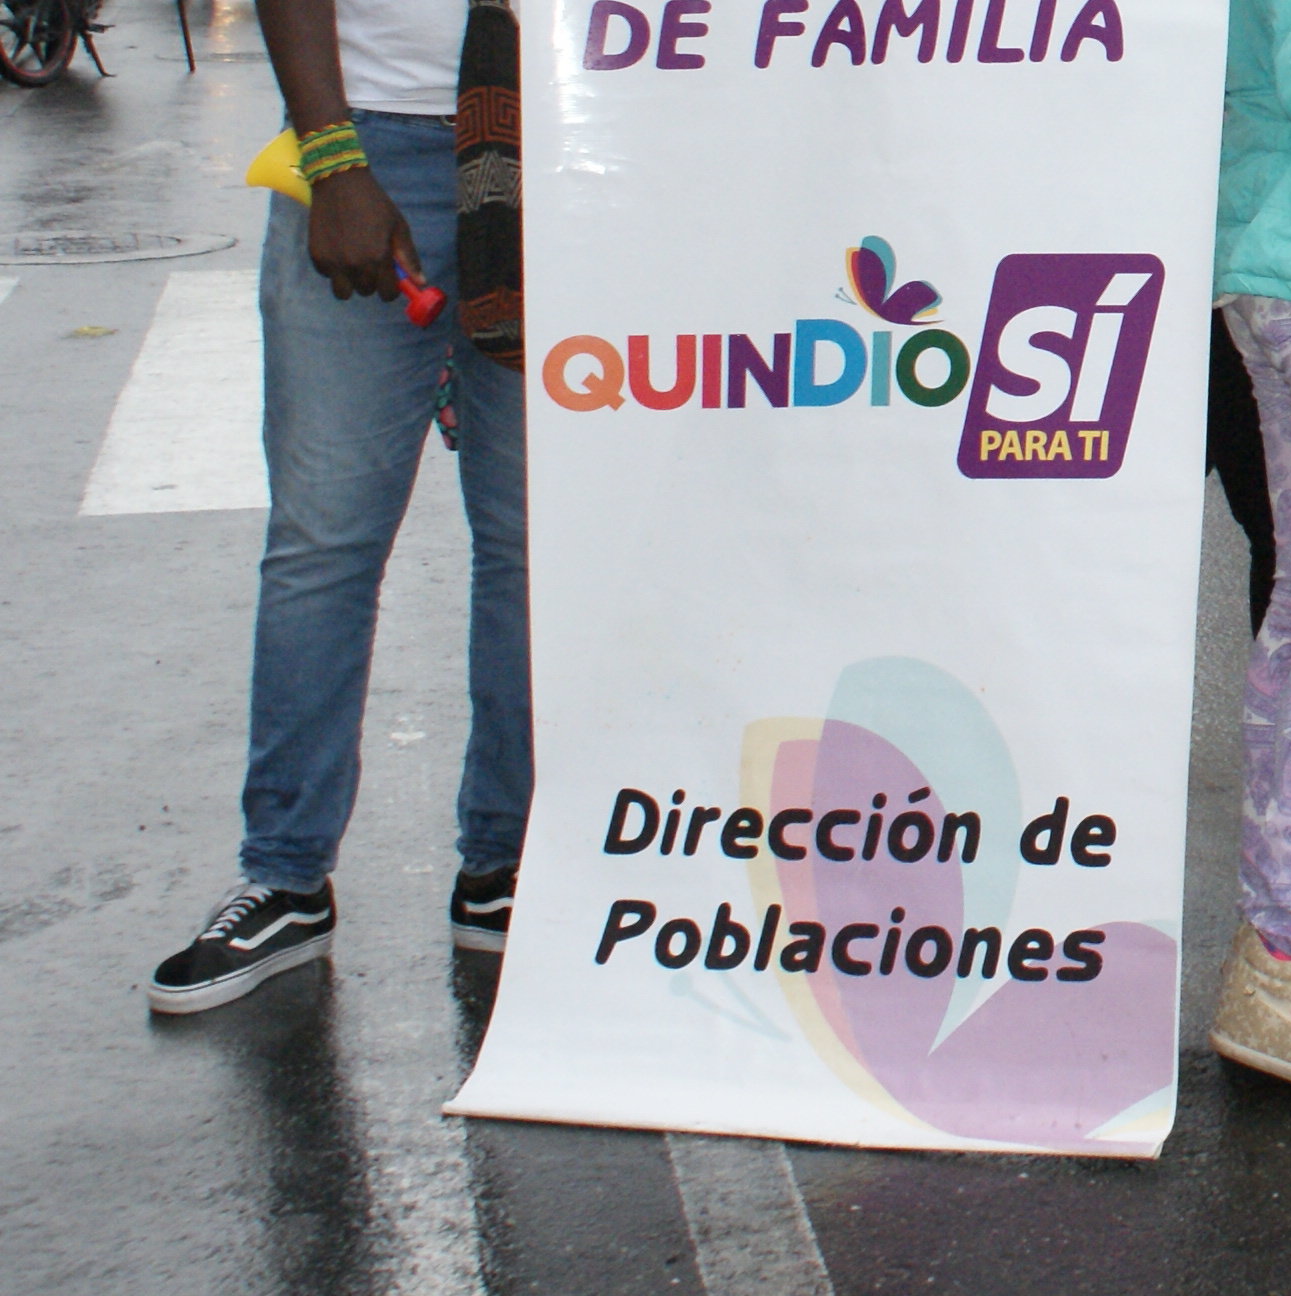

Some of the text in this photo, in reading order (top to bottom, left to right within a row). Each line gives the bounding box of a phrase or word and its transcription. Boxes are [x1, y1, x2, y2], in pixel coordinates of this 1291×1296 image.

[582, 0, 712, 70] DE
[984, 272, 1153, 423] SÍ
[979, 429, 1110, 462] PARA TI
[603, 785, 1118, 868] Dirección de
[594, 898, 1107, 984] Poblaciones
